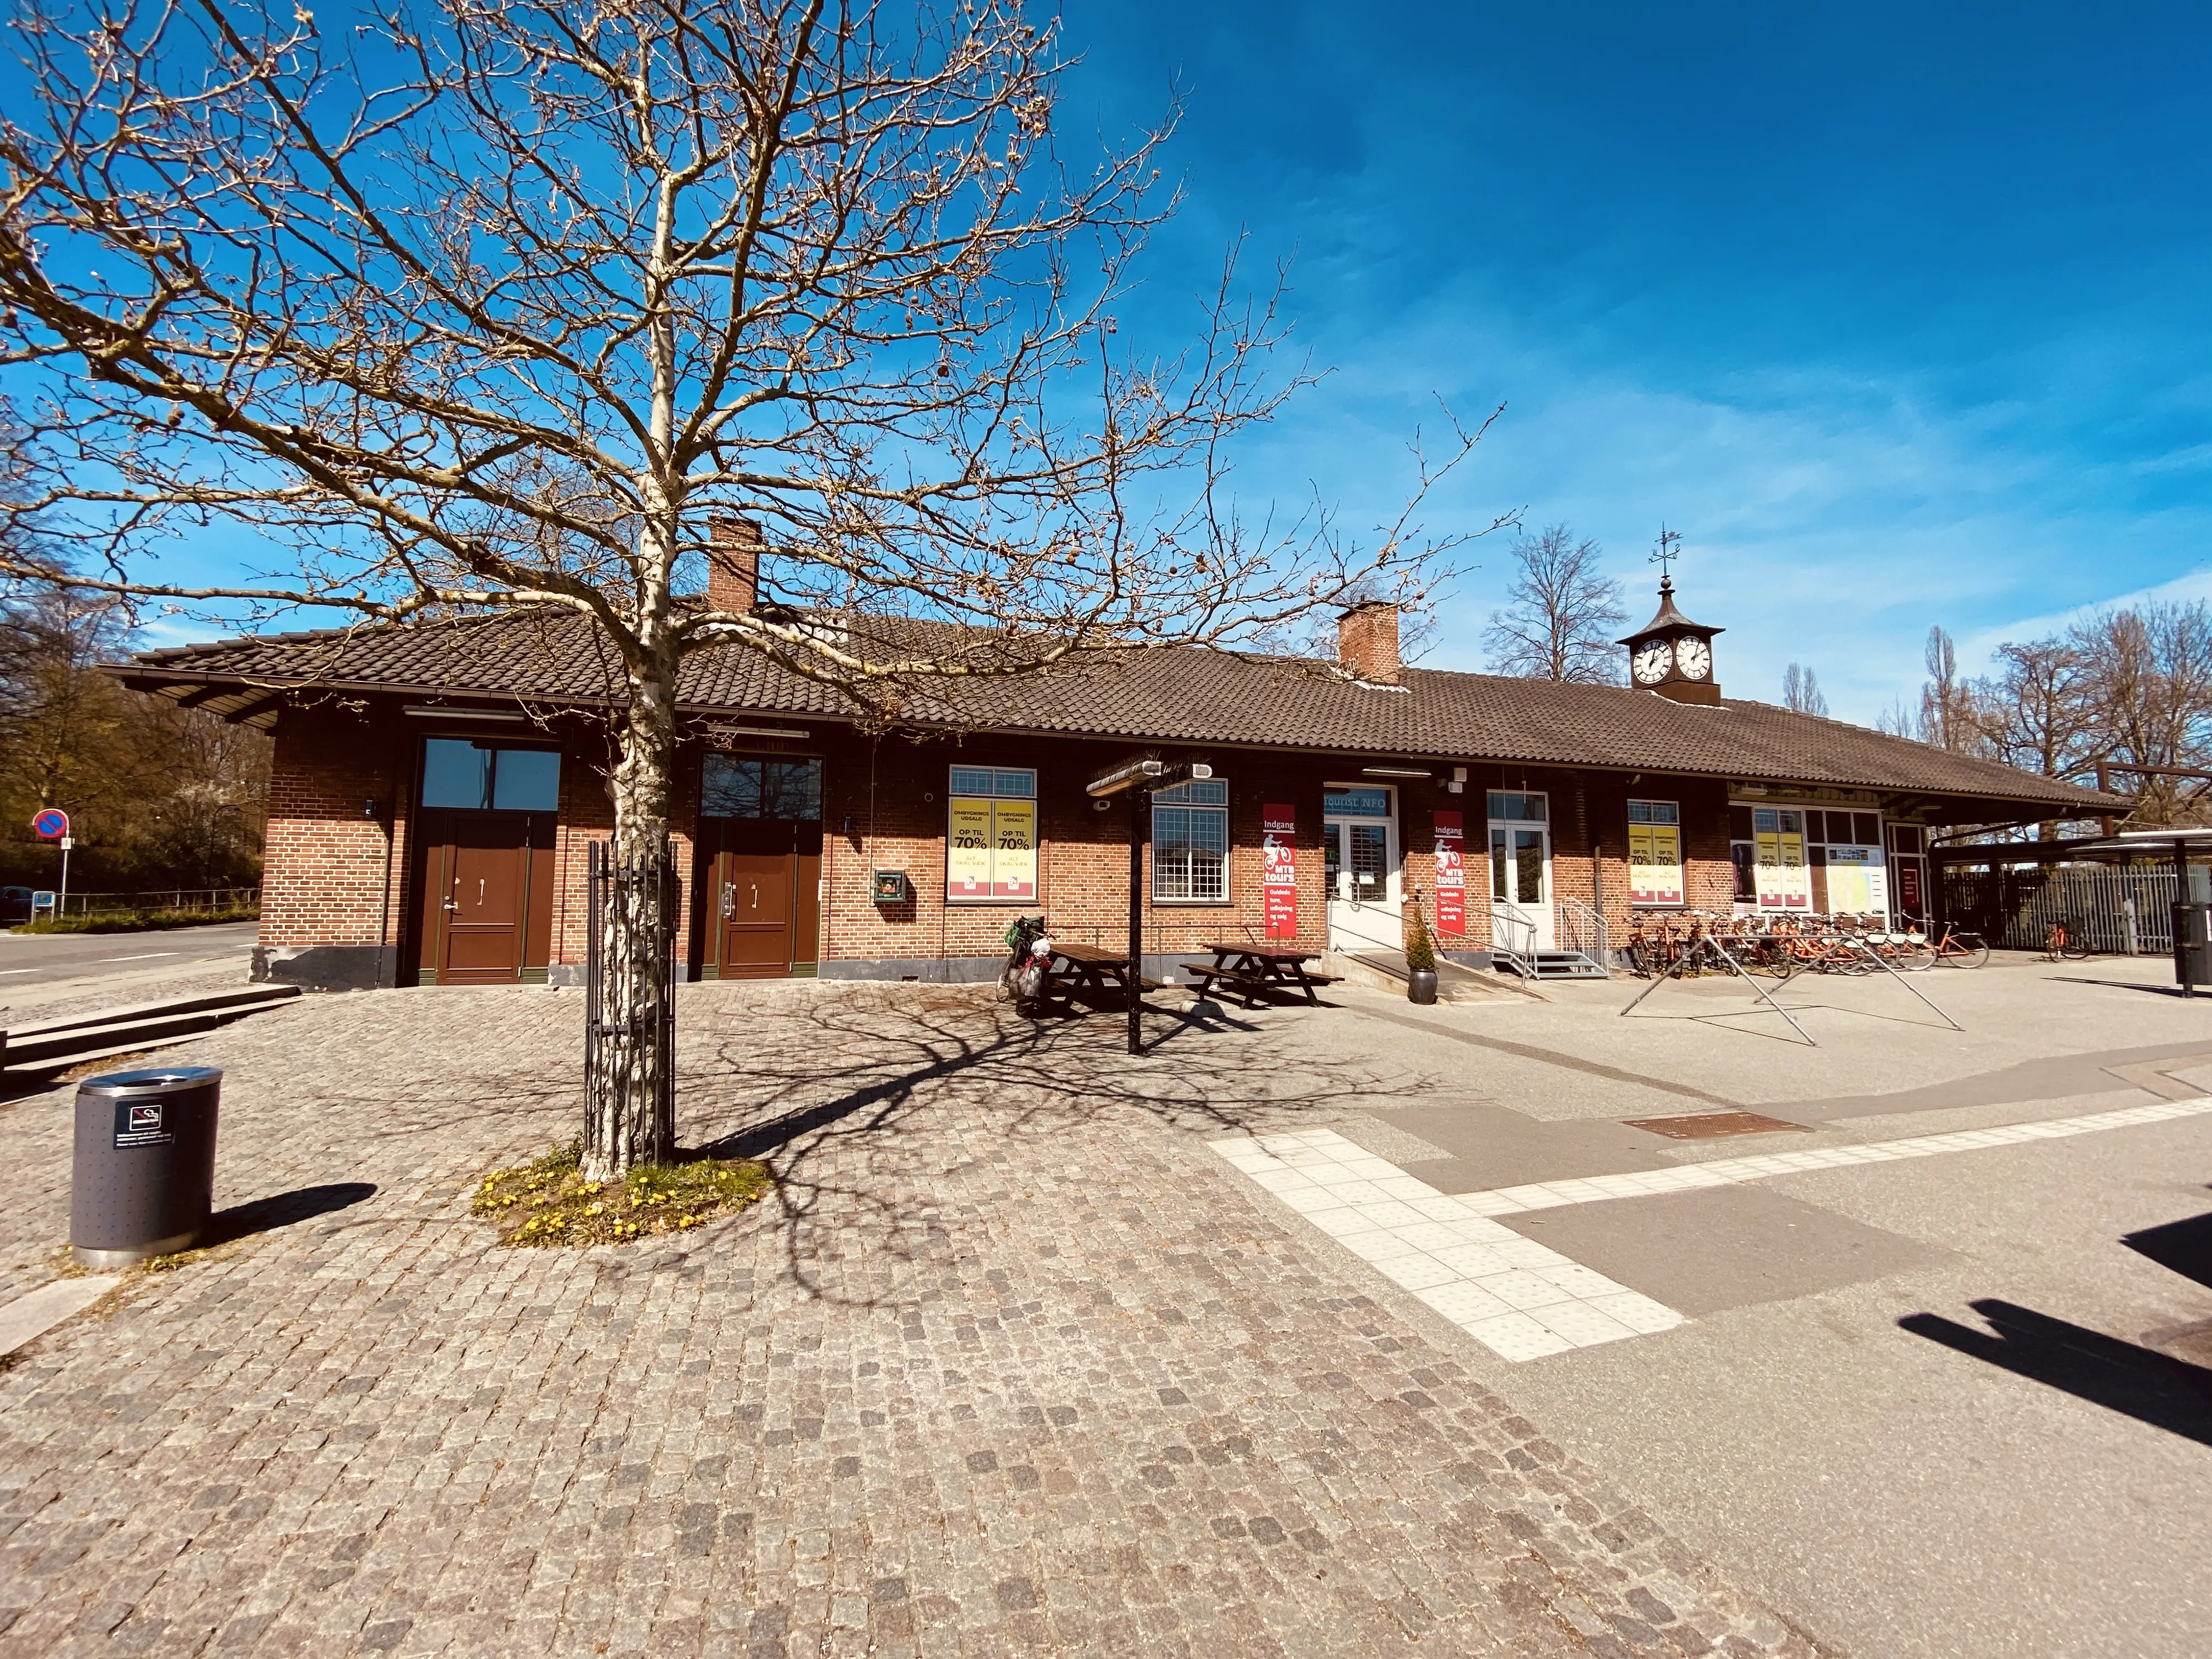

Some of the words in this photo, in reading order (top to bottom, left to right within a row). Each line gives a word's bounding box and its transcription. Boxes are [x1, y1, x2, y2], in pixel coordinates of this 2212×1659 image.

[1264, 820, 1294, 830] Indgang
[1435, 826, 1462, 835] Indgang
[954, 837, 987, 849] 70%
[998, 838, 1030, 850] 70%
[1631, 855, 1651, 865] 70%
[1657, 856, 1677, 866] 70%
[1275, 865, 1295, 874] MTB
[1446, 868, 1464, 876] MTB
[1265, 871, 1295, 882] tours
[1437, 874, 1464, 884] tours
